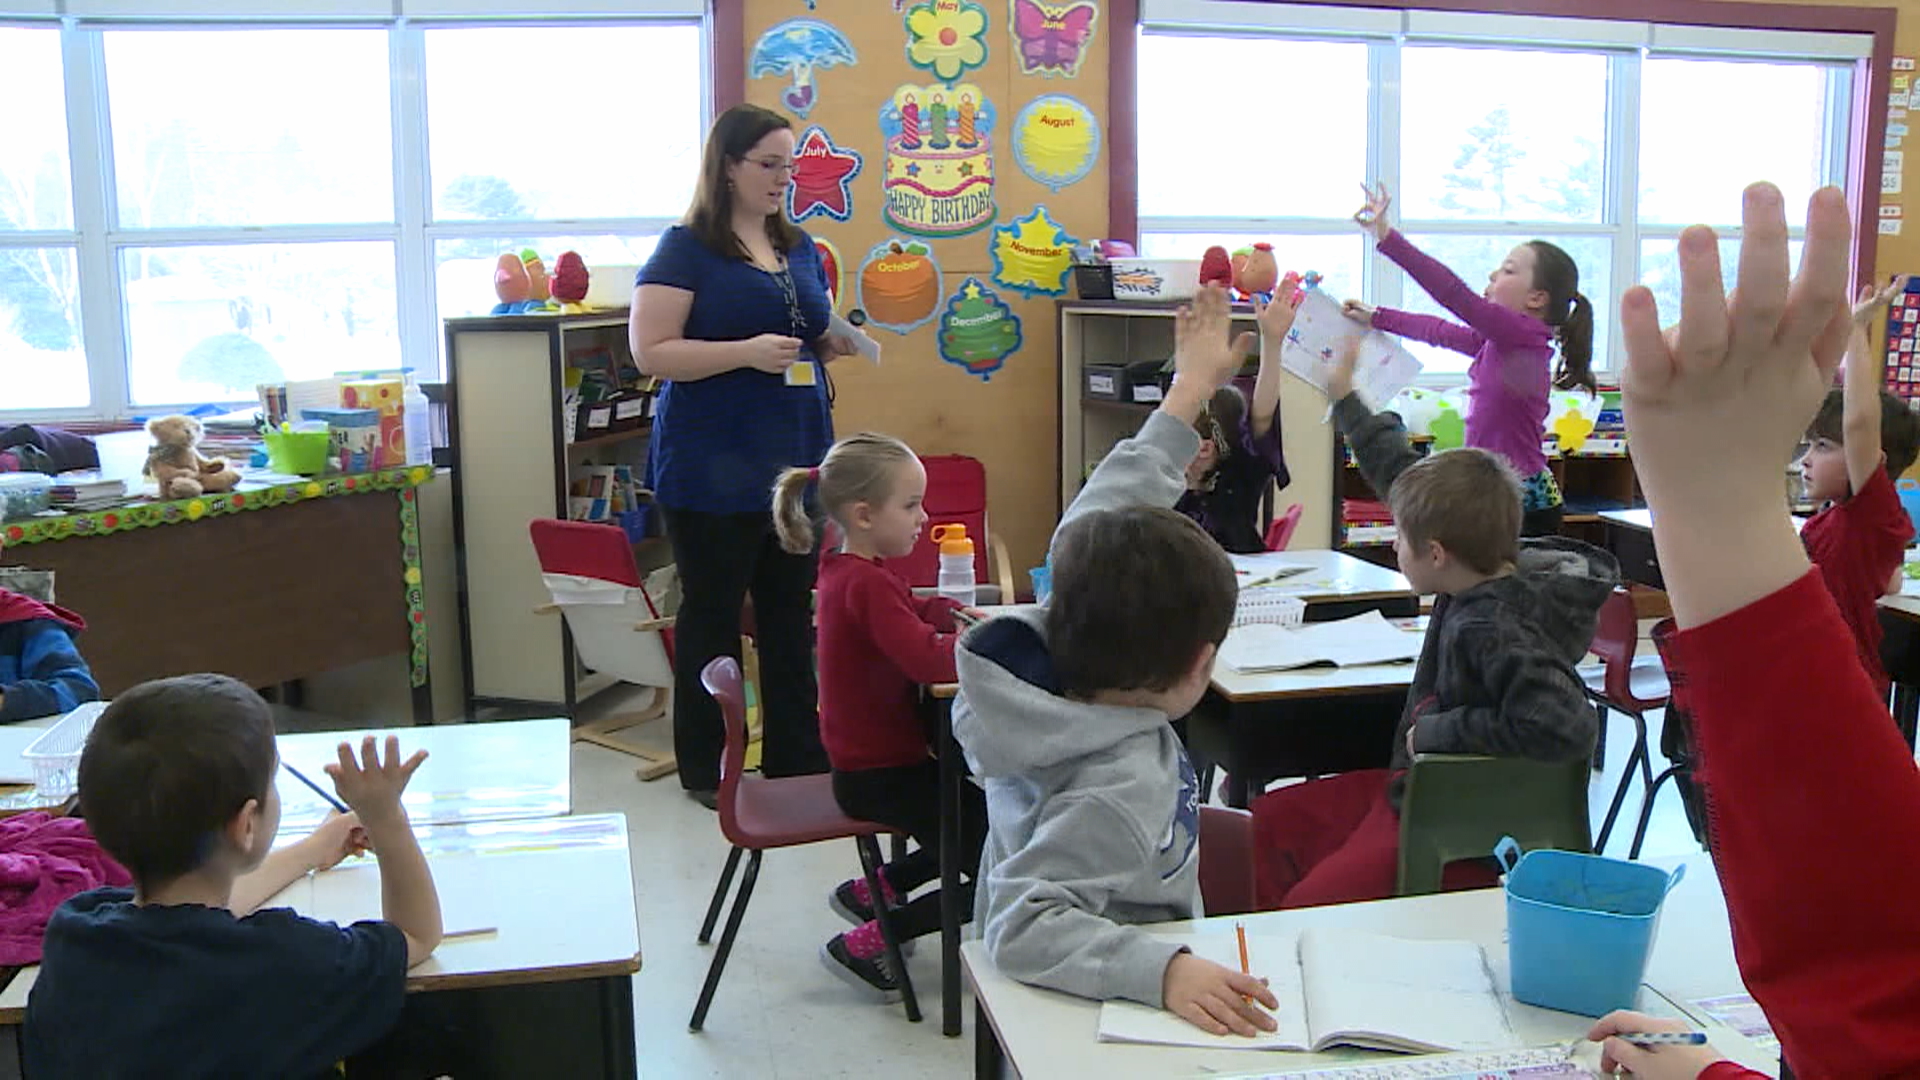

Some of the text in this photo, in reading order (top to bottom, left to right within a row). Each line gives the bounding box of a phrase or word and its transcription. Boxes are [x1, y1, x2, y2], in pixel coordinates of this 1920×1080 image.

[937, 1, 959, 14] May
[1041, 19, 1066, 31] June
[1040, 114, 1076, 130] August
[803, 146, 828, 160] July
[888, 190, 991, 224] HAPPY BIRTHDAY
[1010, 240, 1063, 257] November
[876, 260, 920, 273] October
[950, 309, 1004, 327] December
